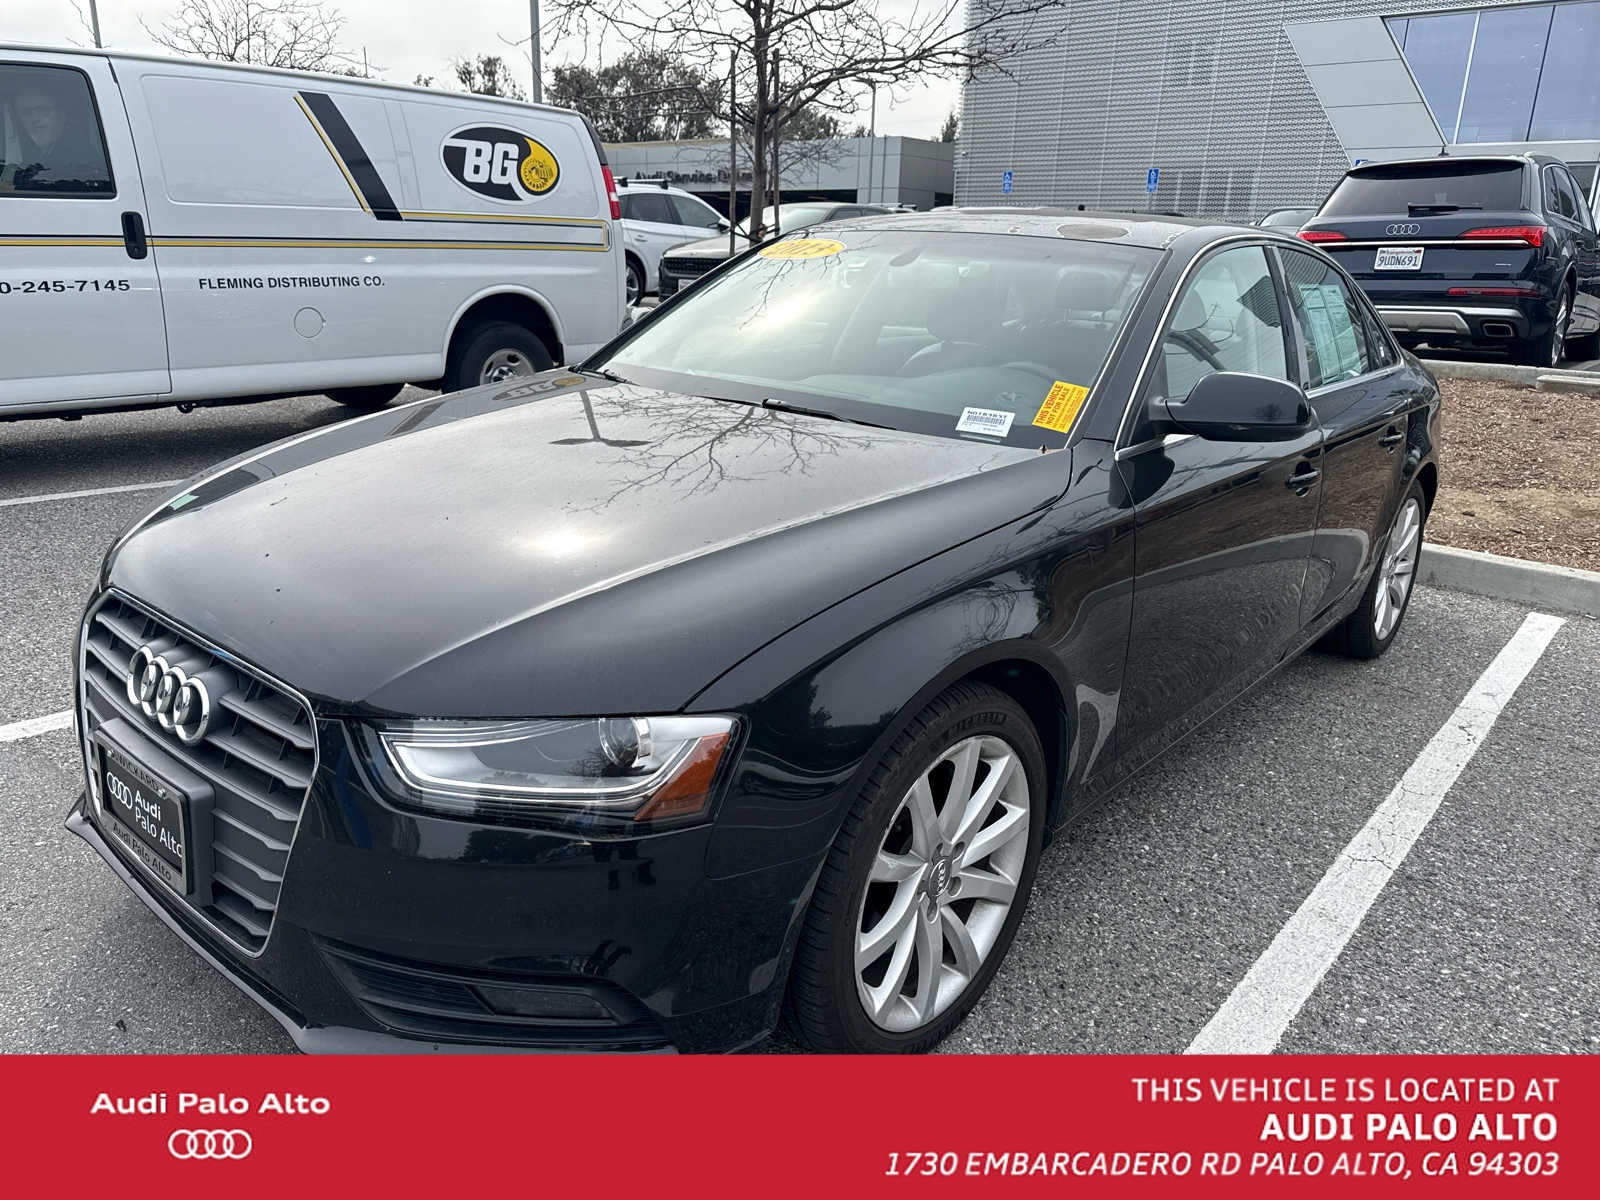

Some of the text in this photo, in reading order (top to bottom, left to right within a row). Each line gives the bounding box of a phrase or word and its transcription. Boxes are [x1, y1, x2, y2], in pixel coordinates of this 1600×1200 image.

[463, 138, 519, 186] BG
[0, 280, 130, 294] 0-245-7145
[199, 275, 385, 289] FLEMING DISTRIBUTING CO.
[1036, 408, 1050, 424] THIS
[1046, 384, 1064, 409] VEHICLE
[135, 790, 161, 821] Audi
[113, 822, 172, 880] Audi Palo Alto
[135, 806, 183, 858] Palo Alto
